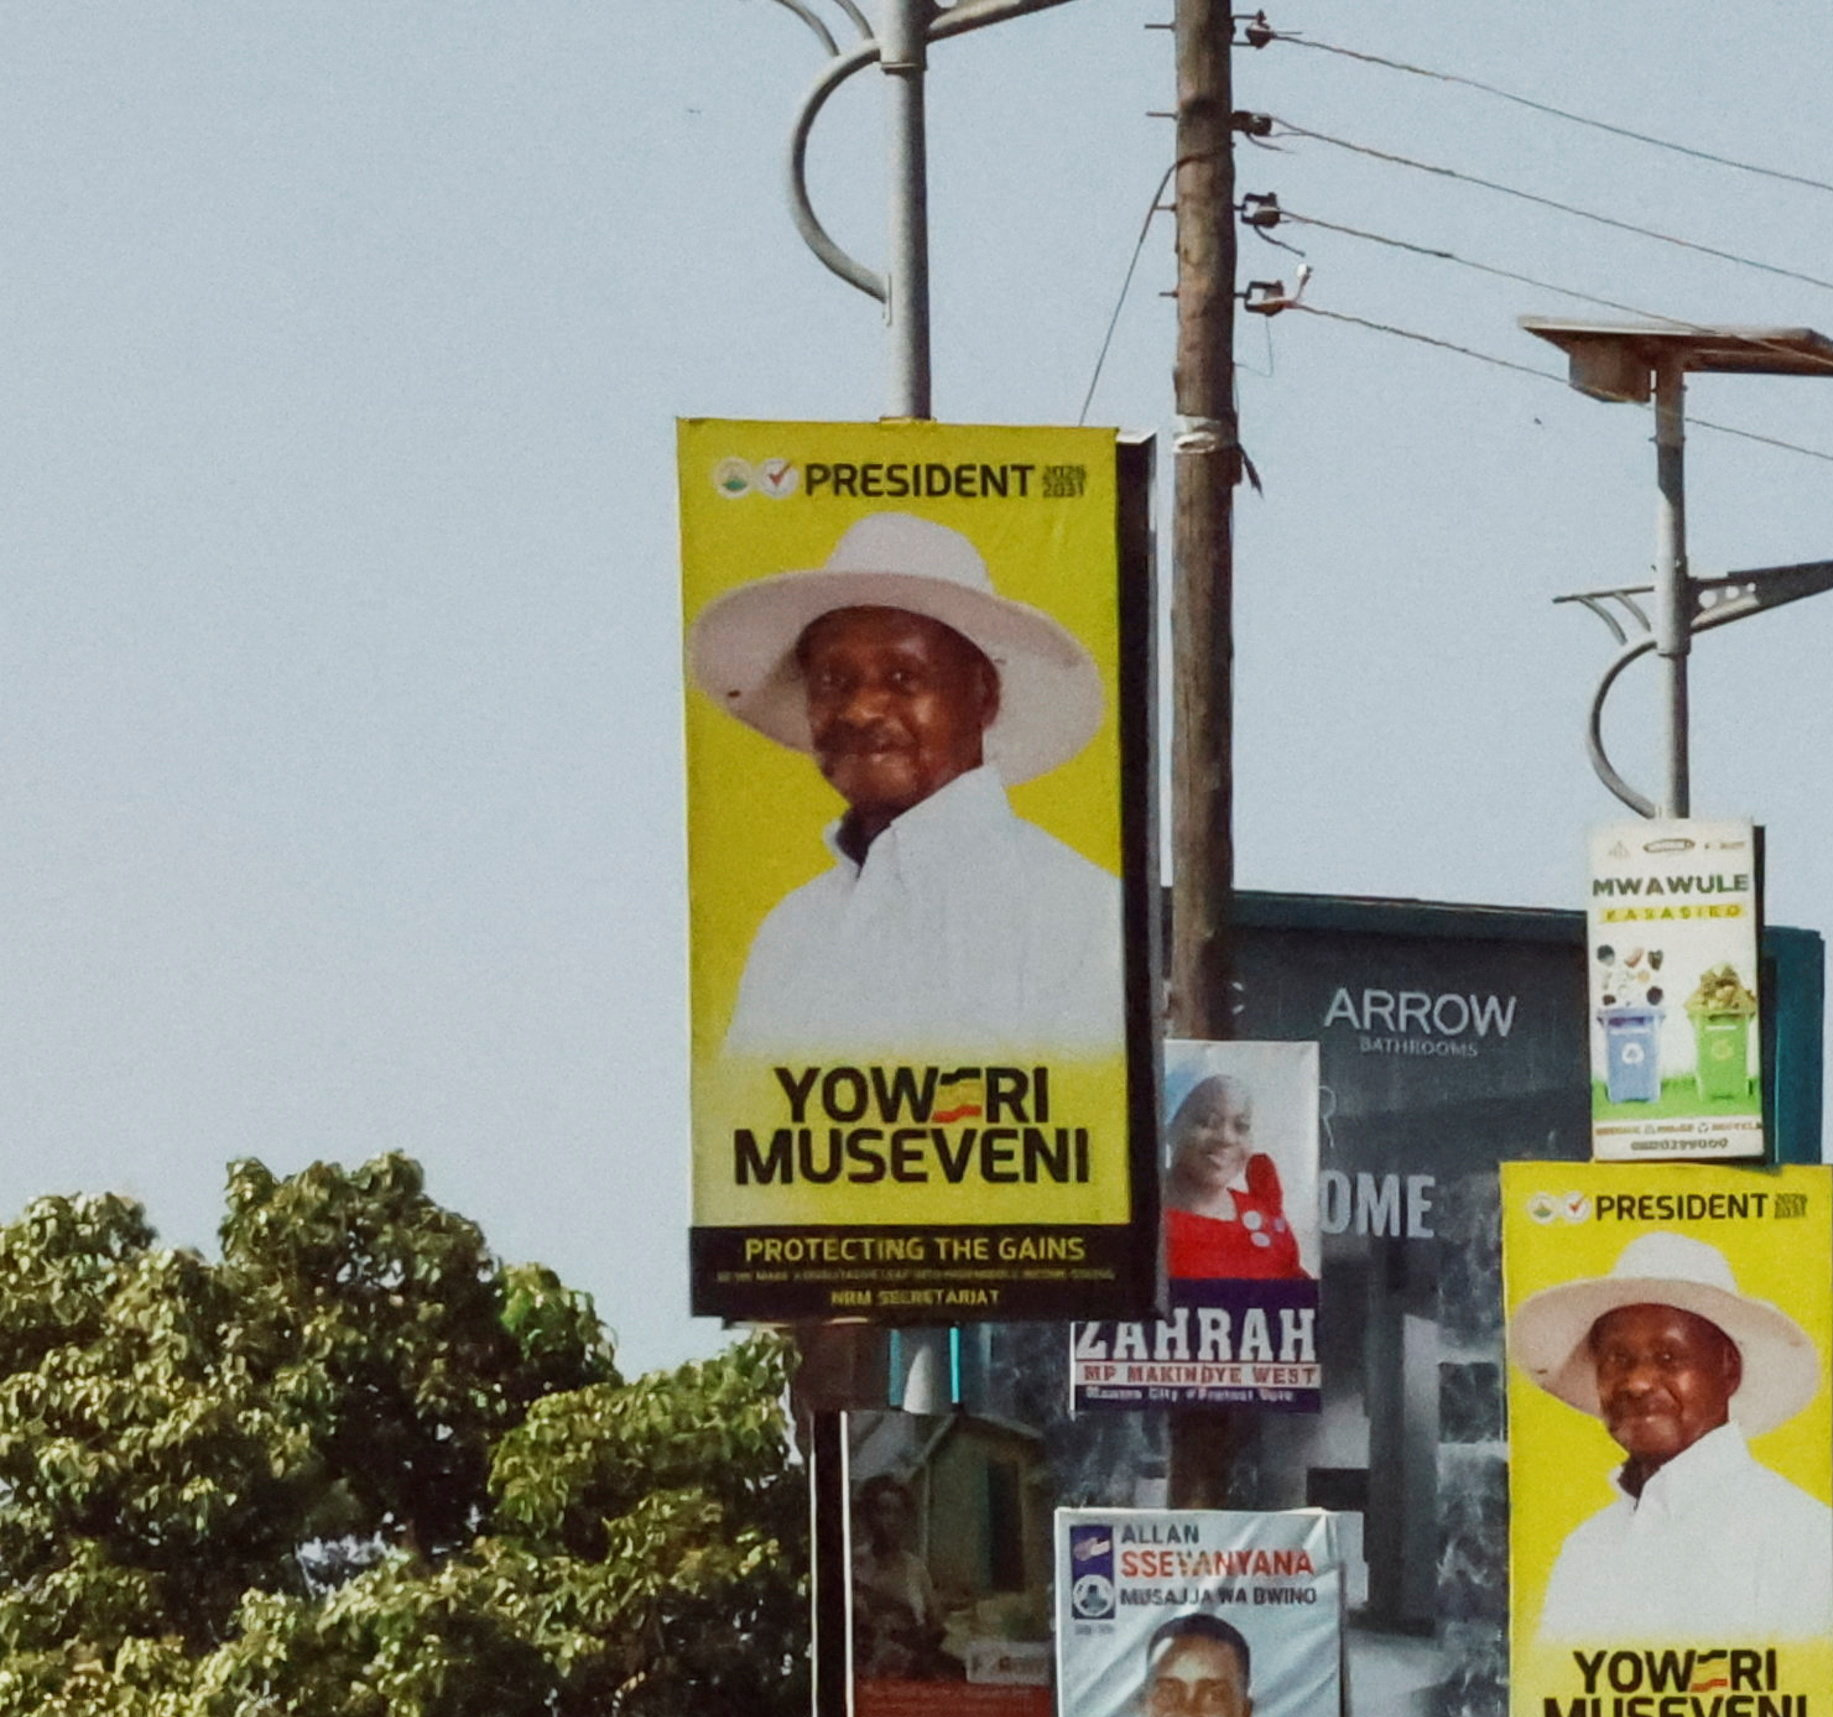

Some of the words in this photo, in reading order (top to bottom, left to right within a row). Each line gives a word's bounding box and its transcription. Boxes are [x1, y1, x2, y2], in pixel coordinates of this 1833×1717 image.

[805, 463, 1034, 497] PRESIDENT
[1592, 874, 1748, 897] MWAWULE
[1324, 987, 1516, 1037] ARROW
[1360, 1036, 1478, 1057] BATHROOMS
[774, 1066, 1048, 1123] YOWERI
[734, 1128, 1089, 1185] MUSEVENI
[1320, 1170, 1435, 1238] OME
[1596, 1194, 1769, 1221] PRESIDENT
[746, 1238, 924, 1261] PROTECTING
[935, 1238, 988, 1260] THE
[1001, 1238, 1084, 1260] GAINS
[1076, 1308, 1316, 1361] ZAHRAH
[1084, 1365, 1117, 1381] MP
[1127, 1365, 1242, 1383] MAKINDYE
[1253, 1367, 1316, 1384] WEST
[1121, 1525, 1198, 1544] ALLAN
[1573, 1648, 1777, 1694] YOWERI
